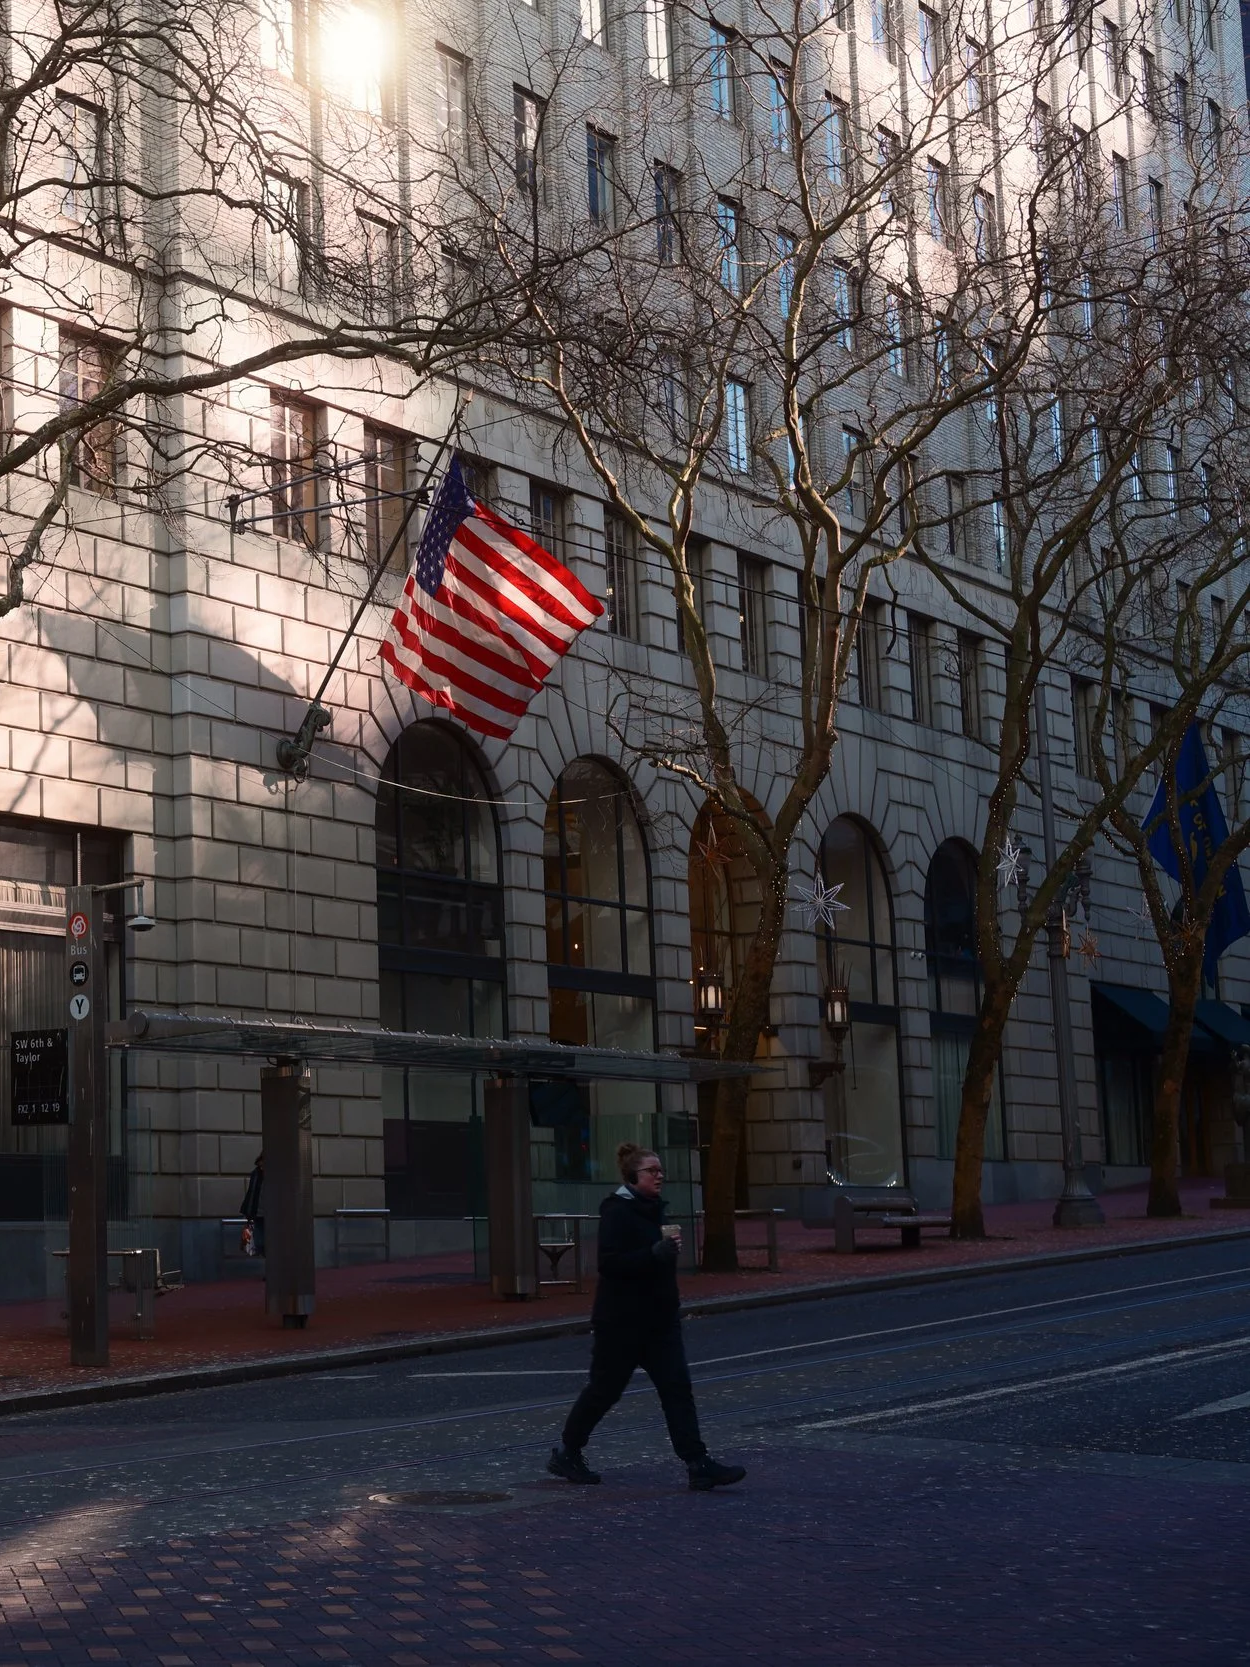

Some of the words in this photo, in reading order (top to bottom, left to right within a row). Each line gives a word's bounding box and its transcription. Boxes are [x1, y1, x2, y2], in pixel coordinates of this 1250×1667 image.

[70, 945, 87, 955] Bus
[15, 1039, 28, 1049] SW
[30, 1037, 44, 1048] 6th
[47, 1037, 53, 1047] &
[15, 1051, 40, 1064] Taylor
[41, 1103, 49, 1112] 12
[52, 1102, 60, 1112] 19
